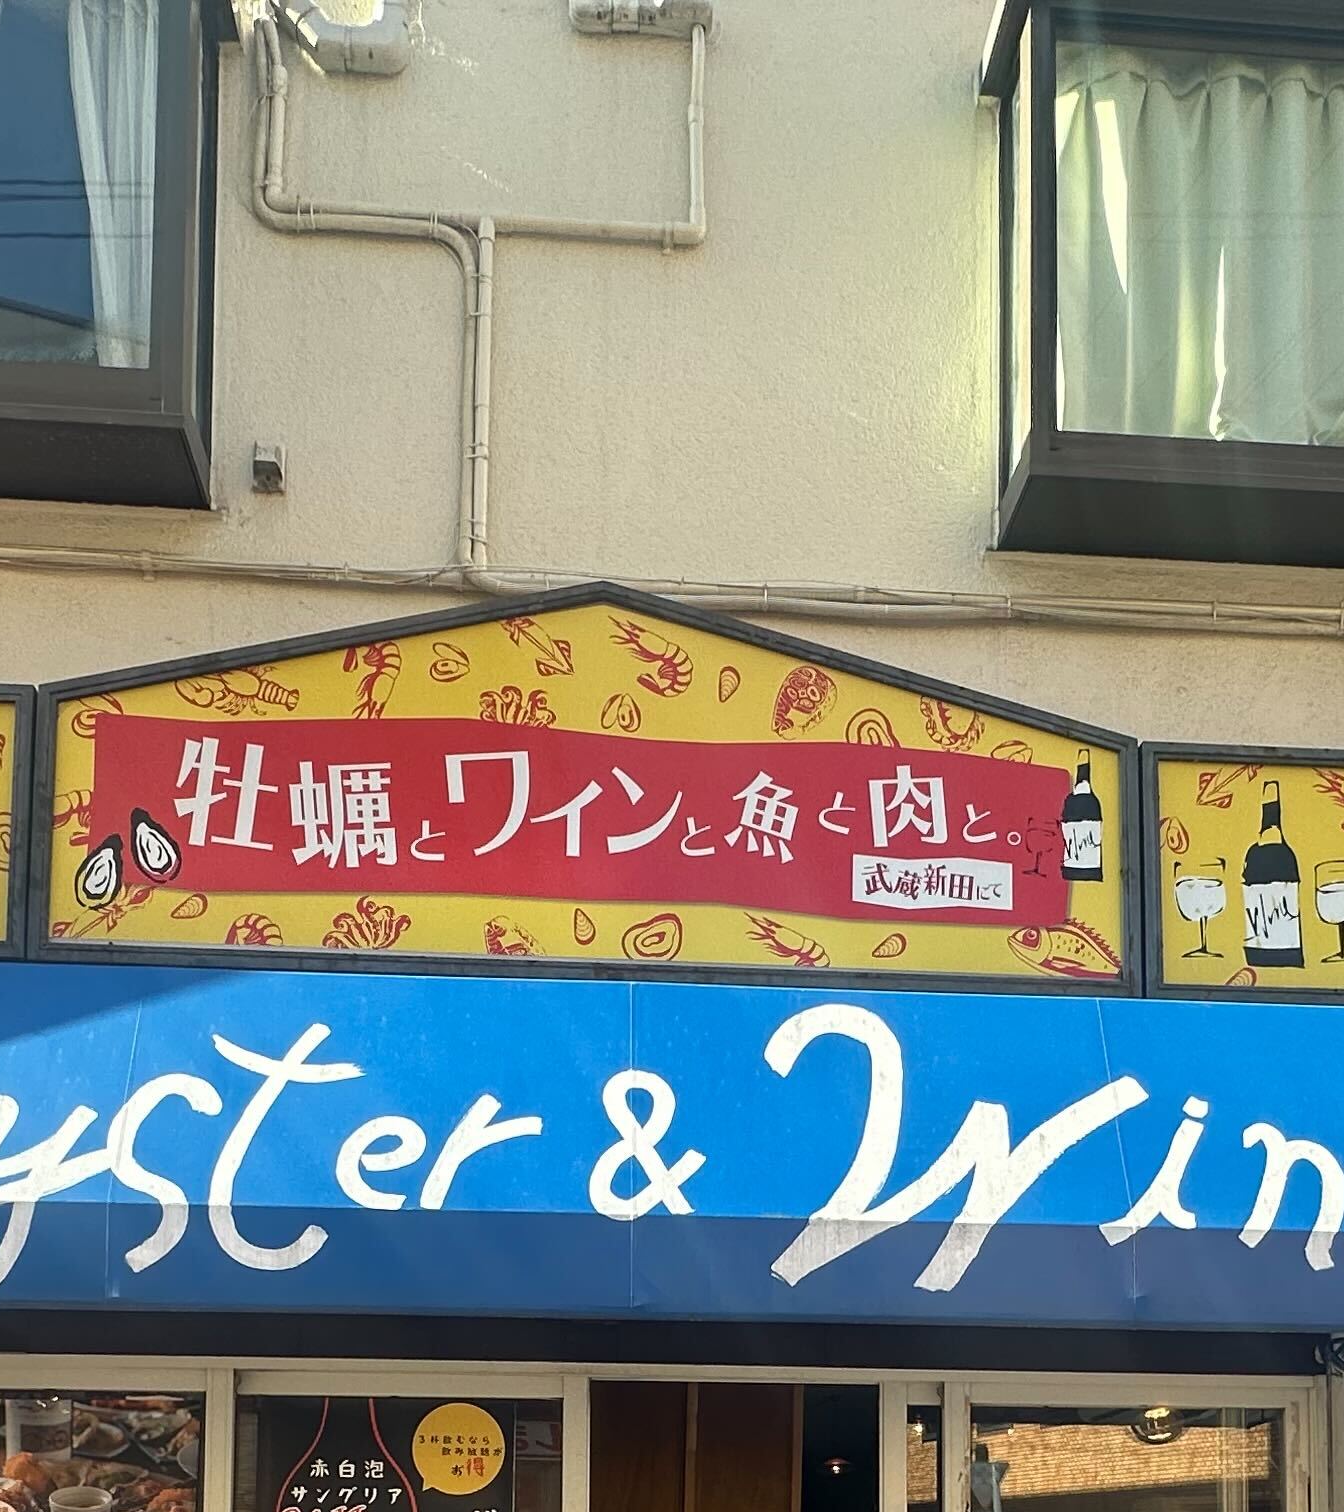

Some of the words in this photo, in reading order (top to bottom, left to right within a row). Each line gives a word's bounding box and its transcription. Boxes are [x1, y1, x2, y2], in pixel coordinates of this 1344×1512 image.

[174, 737, 1022, 870] 牡蠣とワインと魚と肉と。
[862, 862, 1003, 901] 武蔵新田にて
[588, 1069, 707, 1220] &
[310, 1459, 384, 1479] 赤白泡
[451, 1457, 485, 1477] お得
[290, 1487, 403, 1504] サングリア
